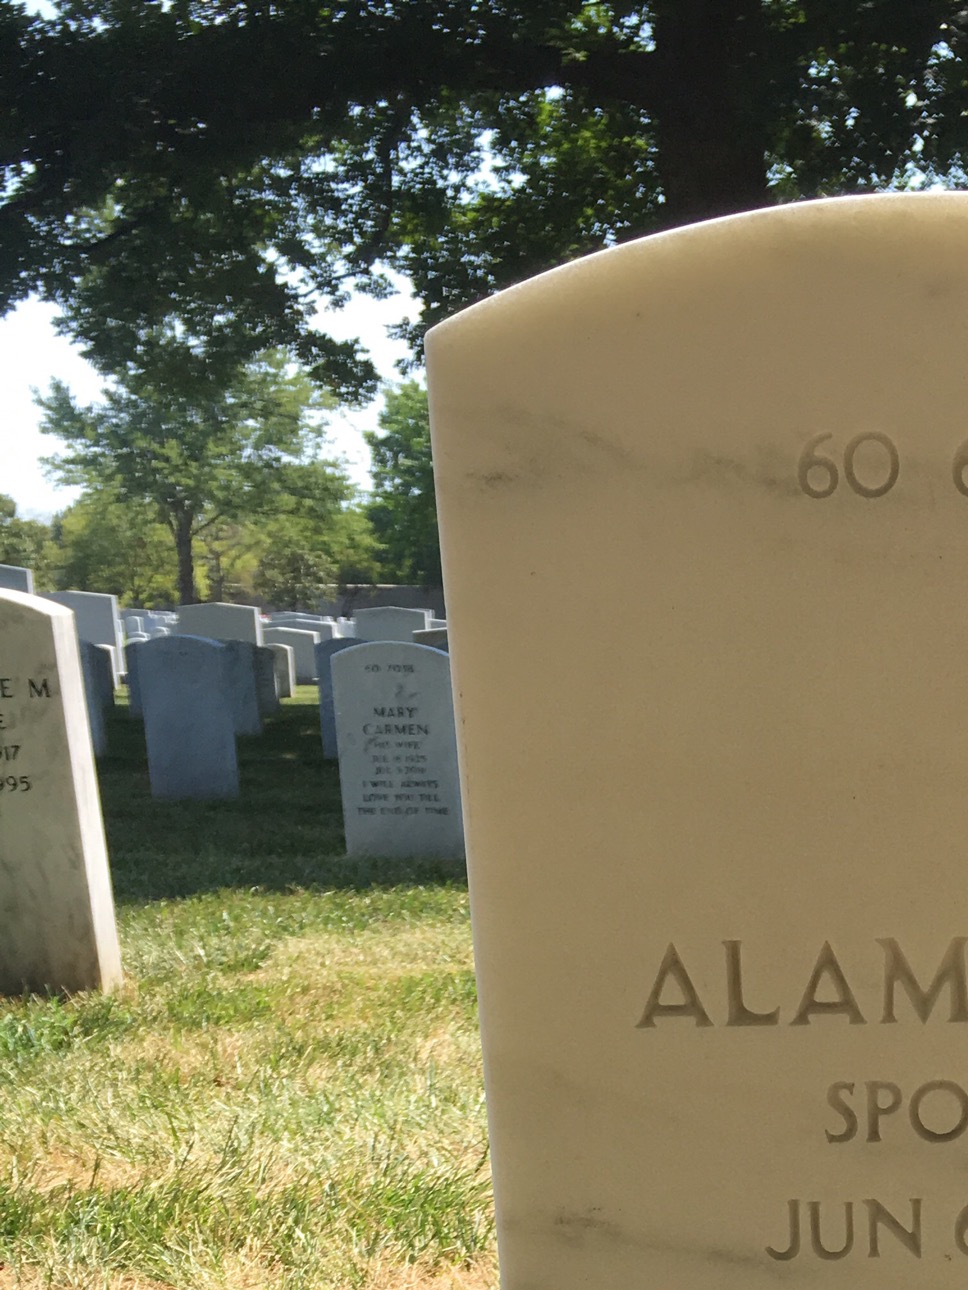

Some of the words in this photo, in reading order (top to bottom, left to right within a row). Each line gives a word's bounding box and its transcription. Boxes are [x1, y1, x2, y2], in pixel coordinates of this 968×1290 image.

[798, 431, 900, 499] 60
[28, 678, 51, 698] M
[374, 707, 418, 718] MARY
[362, 723, 430, 735] CARMEN
[0, 744, 20, 761] 17
[764, 1197, 923, 1262] JUN
